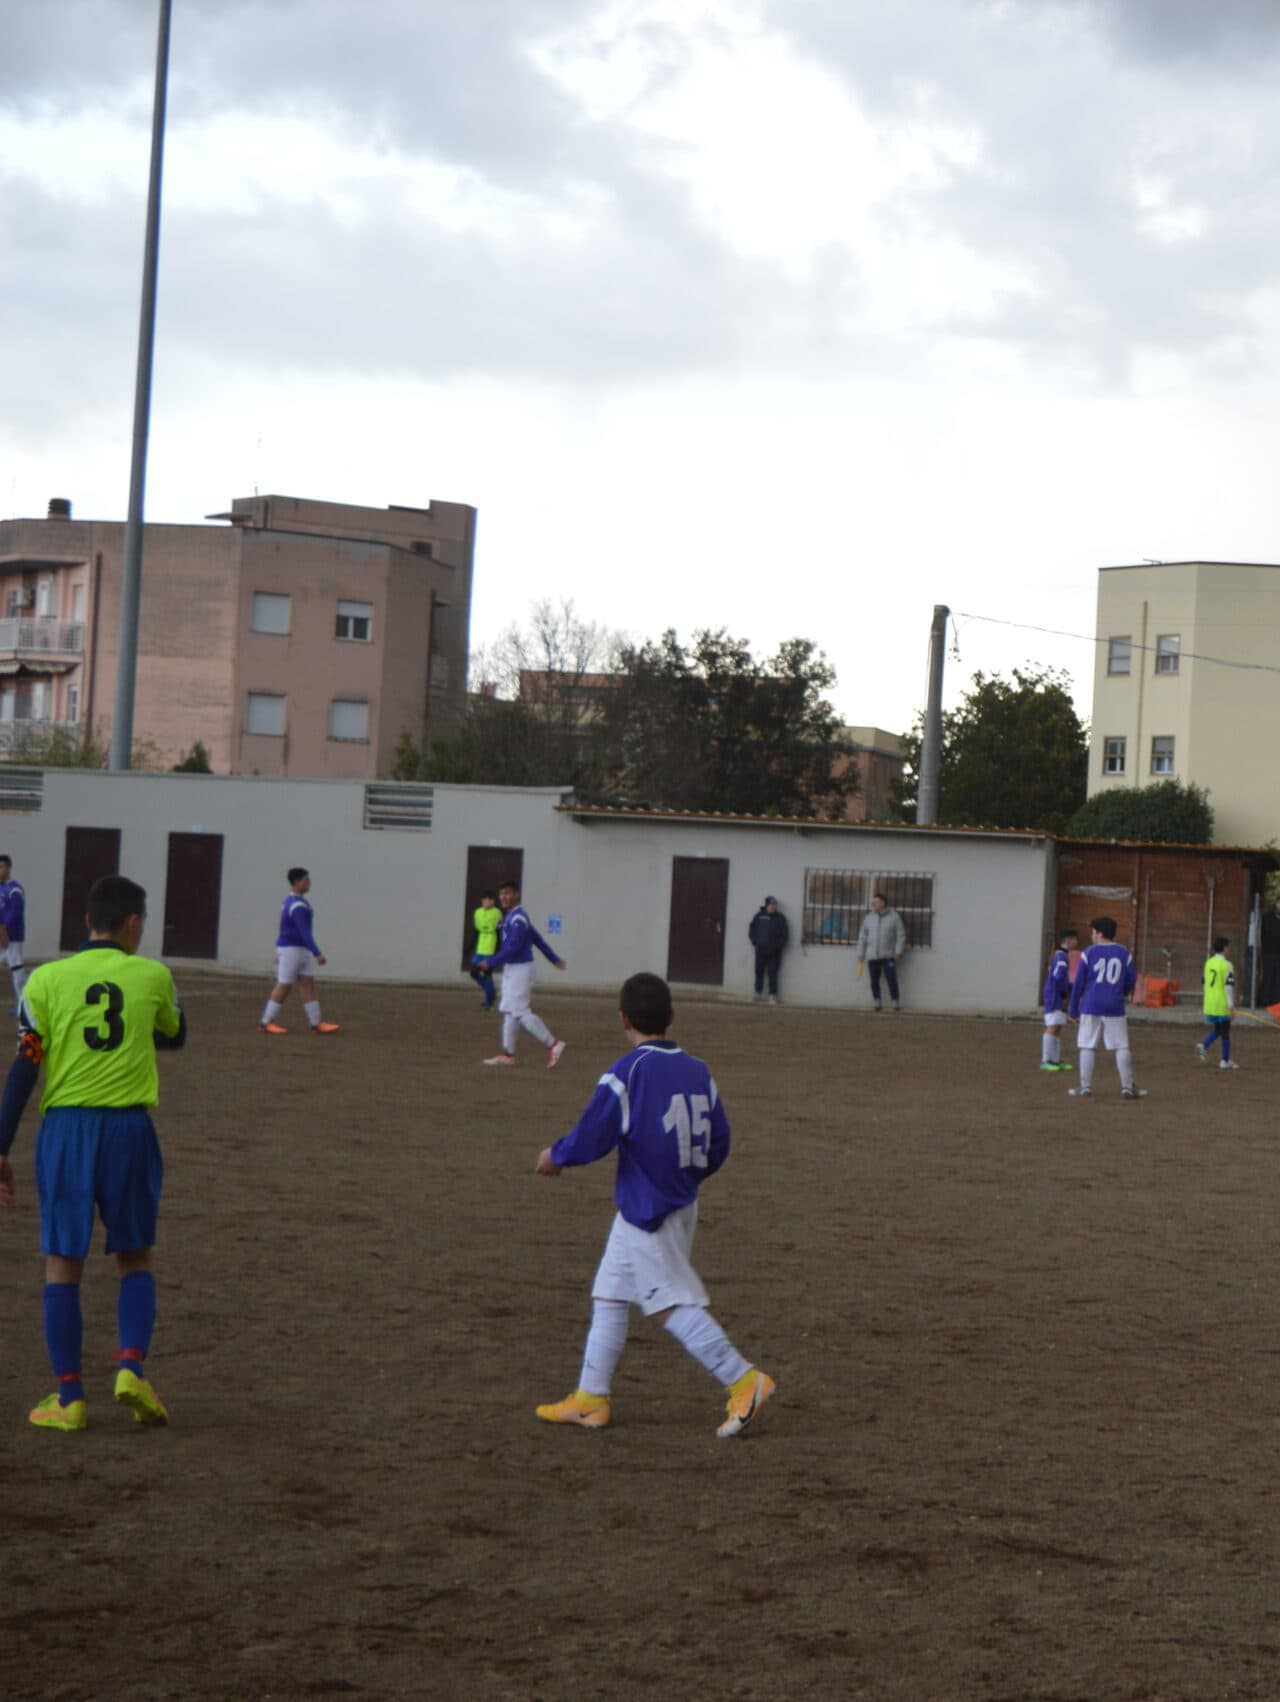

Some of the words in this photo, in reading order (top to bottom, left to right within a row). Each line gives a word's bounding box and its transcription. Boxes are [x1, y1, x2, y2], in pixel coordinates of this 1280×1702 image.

[1094, 957, 1122, 985] 10
[1209, 969, 1218, 987] 7
[84, 981, 125, 1052] 3
[662, 1093, 712, 1168] 15
